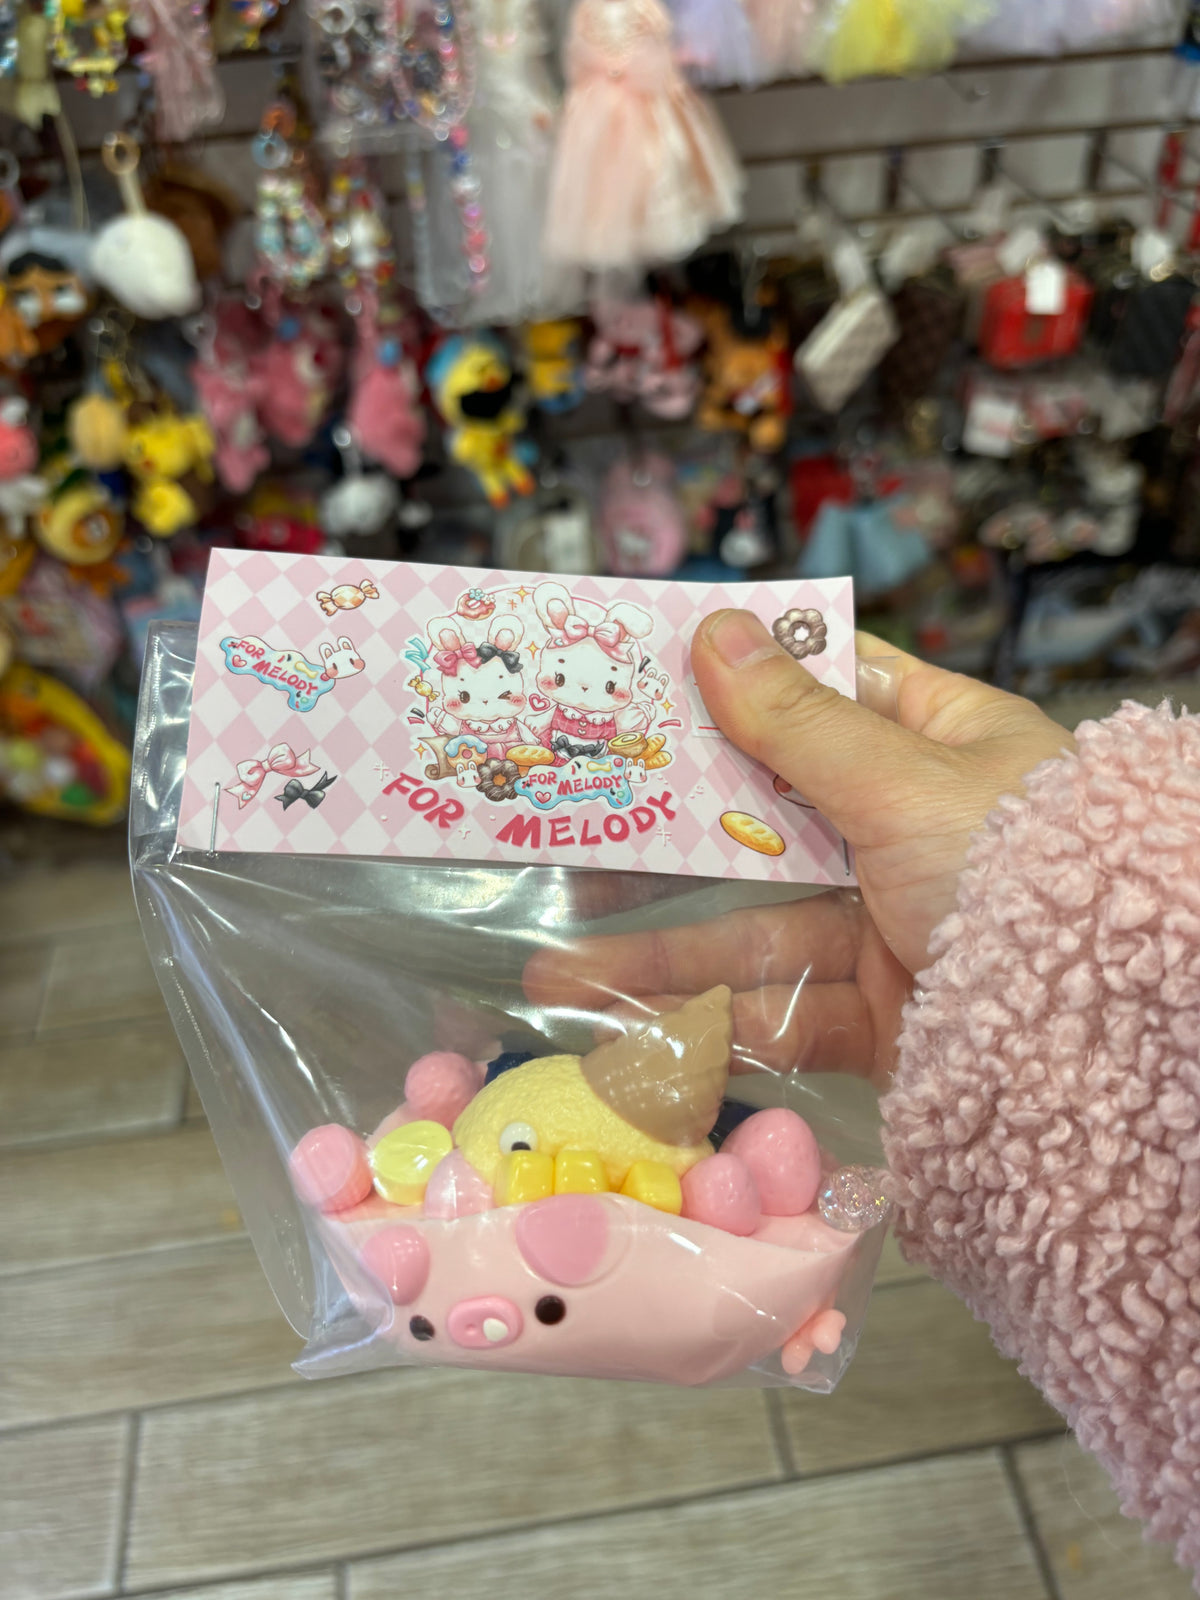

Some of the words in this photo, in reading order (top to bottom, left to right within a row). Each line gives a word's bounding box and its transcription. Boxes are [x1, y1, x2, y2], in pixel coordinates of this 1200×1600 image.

[236, 640, 265, 660] FOR
[252, 660, 318, 695] MELODY
[382, 772, 465, 828] FOR
[495, 791, 676, 849] MELODY
[528, 771, 557, 788] FOR
[557, 775, 622, 796] MELODY
